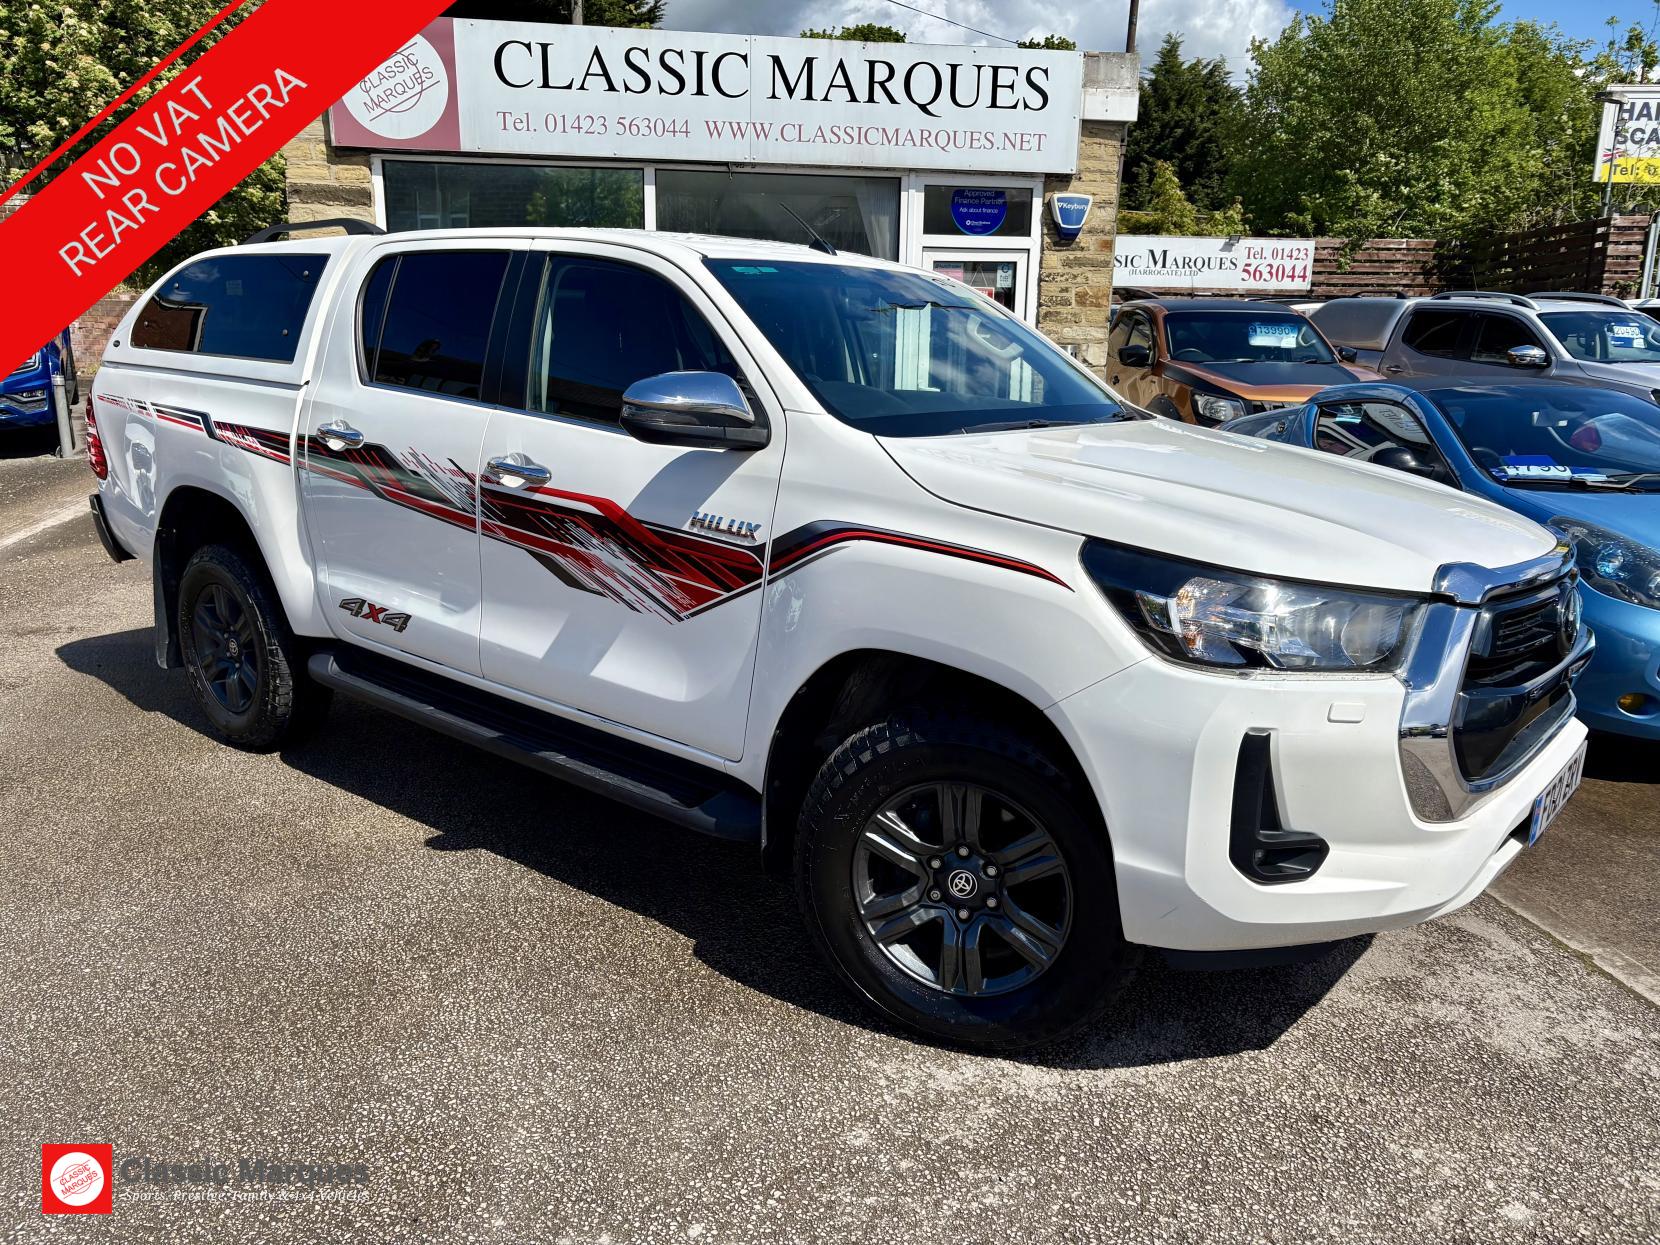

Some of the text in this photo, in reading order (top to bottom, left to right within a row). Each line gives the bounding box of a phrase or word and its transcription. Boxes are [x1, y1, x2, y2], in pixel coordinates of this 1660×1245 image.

[358, 53, 420, 94] CLASSIC
[494, 40, 1049, 118] CLASSIC MARQUES
[363, 66, 434, 115] MARQUES
[1620, 102, 1660, 121] HA
[496, 111, 1048, 153] Tel. 01423 563044 WWW.CLASSICMARQUES.NET
[963, 189, 995, 198] Approved
[1271, 247, 1309, 261] 01423
[1128, 268, 1183, 277] (HARROGATE)
[1240, 262, 1308, 283] 563044
[689, 511, 762, 542] HILUX
